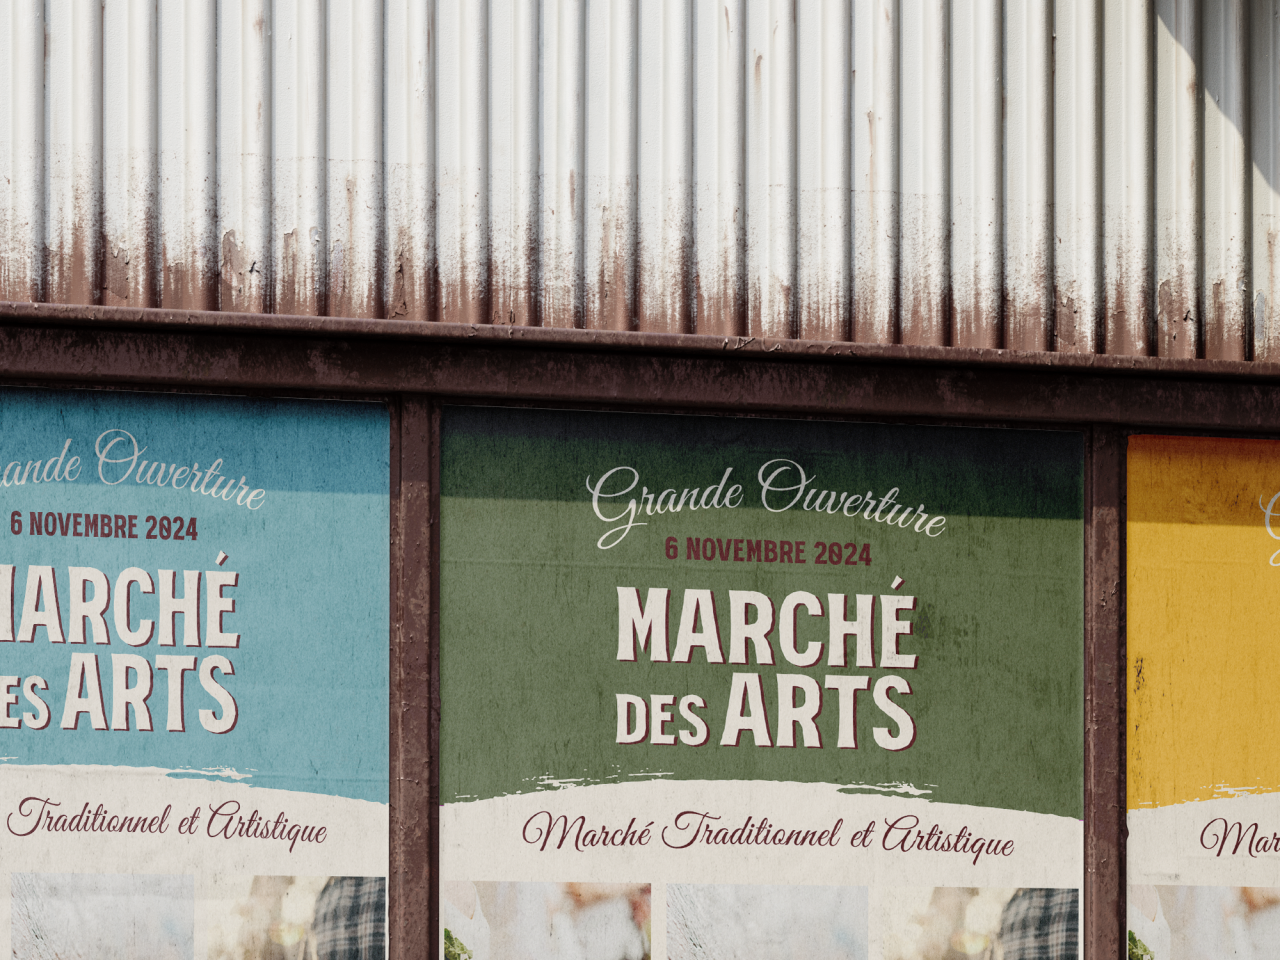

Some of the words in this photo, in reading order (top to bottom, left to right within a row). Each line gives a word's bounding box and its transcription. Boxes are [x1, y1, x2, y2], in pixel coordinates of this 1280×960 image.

[0, 439, 82, 487] ande
[95, 429, 266, 510] Ouverture
[586, 467, 743, 550] Grande
[758, 459, 945, 537] Ouverture
[10, 511, 22, 535] 6
[30, 512, 138, 538] NOVEMBRE
[145, 516, 198, 541] 2024
[665, 537, 679, 560] 6
[686, 538, 805, 565] NOVEMBRE
[814, 542, 872, 566] 2024
[616, 576, 918, 669] MARCHÉ
[60, 652, 239, 734] ARTS
[616, 694, 710, 747] DES
[720, 672, 917, 751] ARTS
[7, 797, 173, 836] Traditionnel
[178, 808, 198, 835] et
[207, 801, 327, 853] Artistique
[523, 813, 651, 852] Marché
[662, 812, 841, 849] Traditionnel
[851, 822, 875, 849] et
[882, 816, 1014, 866] Artistique
